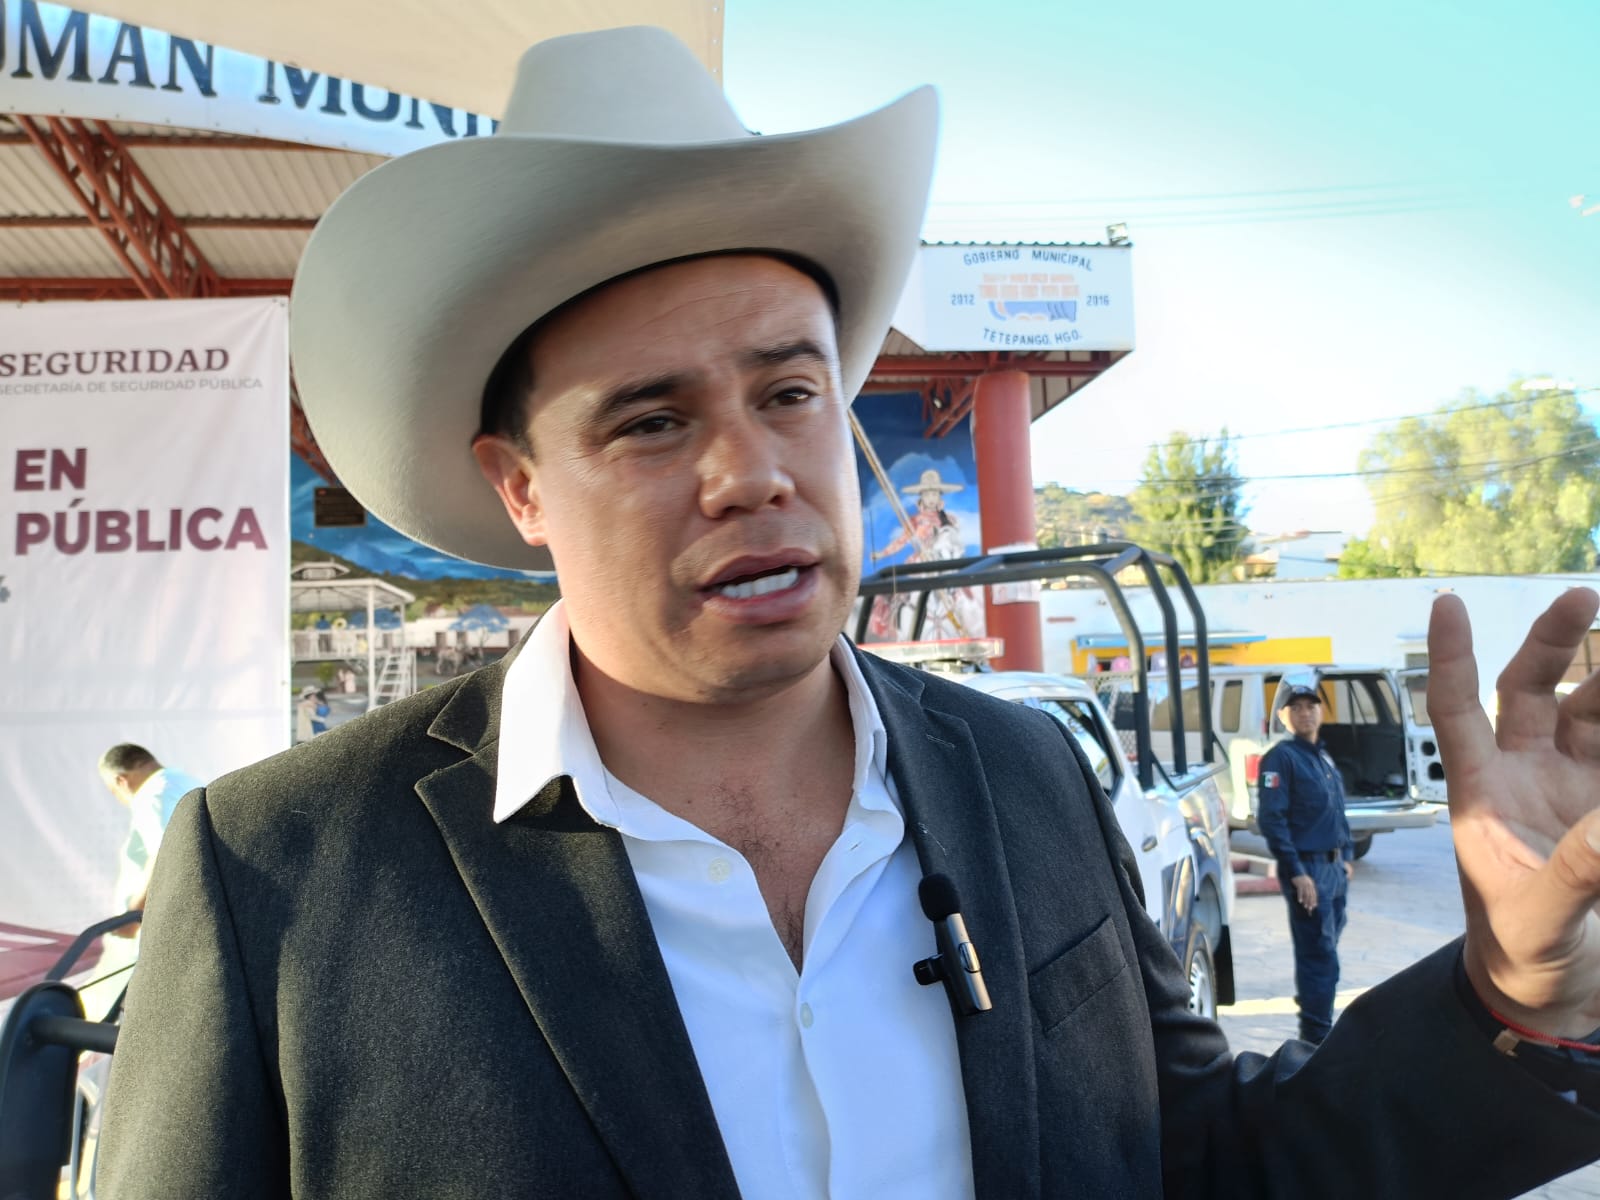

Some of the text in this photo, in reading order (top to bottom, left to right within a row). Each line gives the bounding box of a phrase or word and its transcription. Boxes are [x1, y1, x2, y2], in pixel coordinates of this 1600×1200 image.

[0, 0, 500, 137] MAN MUN
[963, 249, 1093, 271] GOBIERNO MUNICIPAL
[951, 294, 975, 306] 2012
[0, 348, 230, 377] SEGURIDAD
[87, 381, 106, 393] DE
[111, 379, 195, 393] SEGURIDAD
[199, 375, 263, 390] PÚBLICA
[14, 447, 88, 491] EN
[15, 498, 269, 556] PÚBLICA
